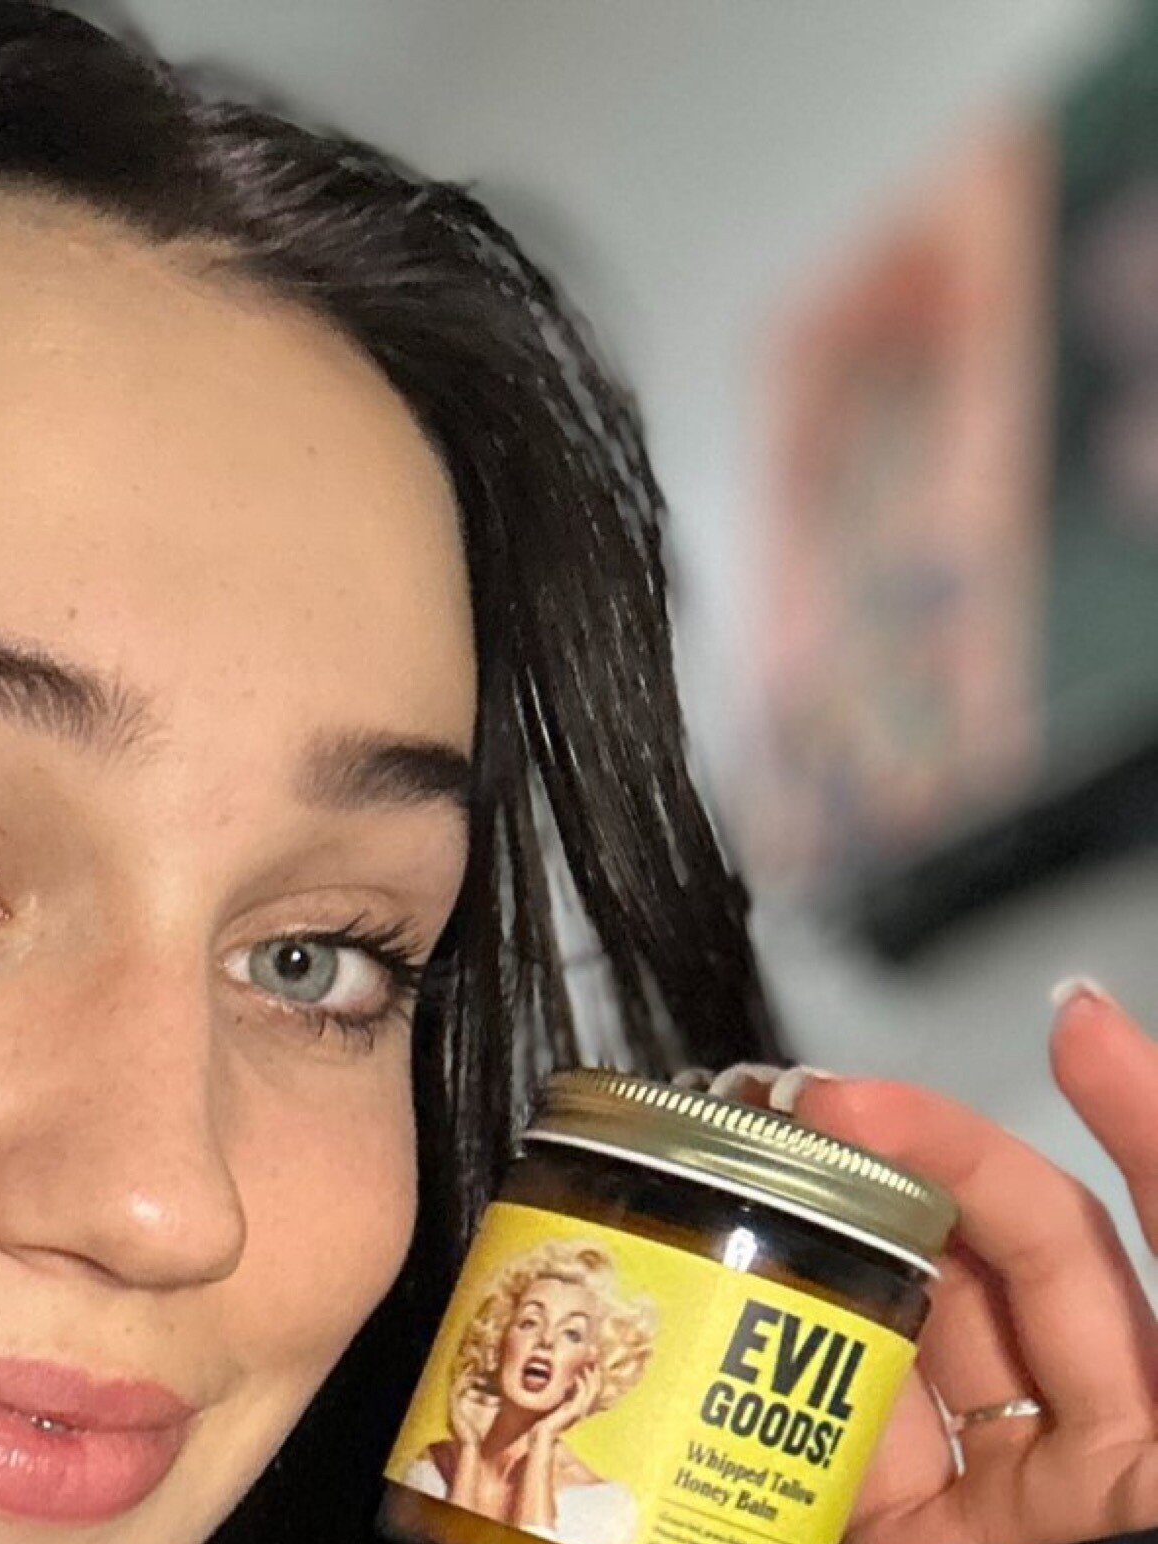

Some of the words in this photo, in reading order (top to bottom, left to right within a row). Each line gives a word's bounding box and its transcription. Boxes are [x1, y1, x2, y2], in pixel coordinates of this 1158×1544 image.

[719, 1298, 866, 1421] EVIL
[700, 1380, 844, 1469] GOODS!
[674, 1466, 731, 1507] Honey
[735, 1488, 779, 1522] Balm
[687, 1440, 768, 1488] Whipped
